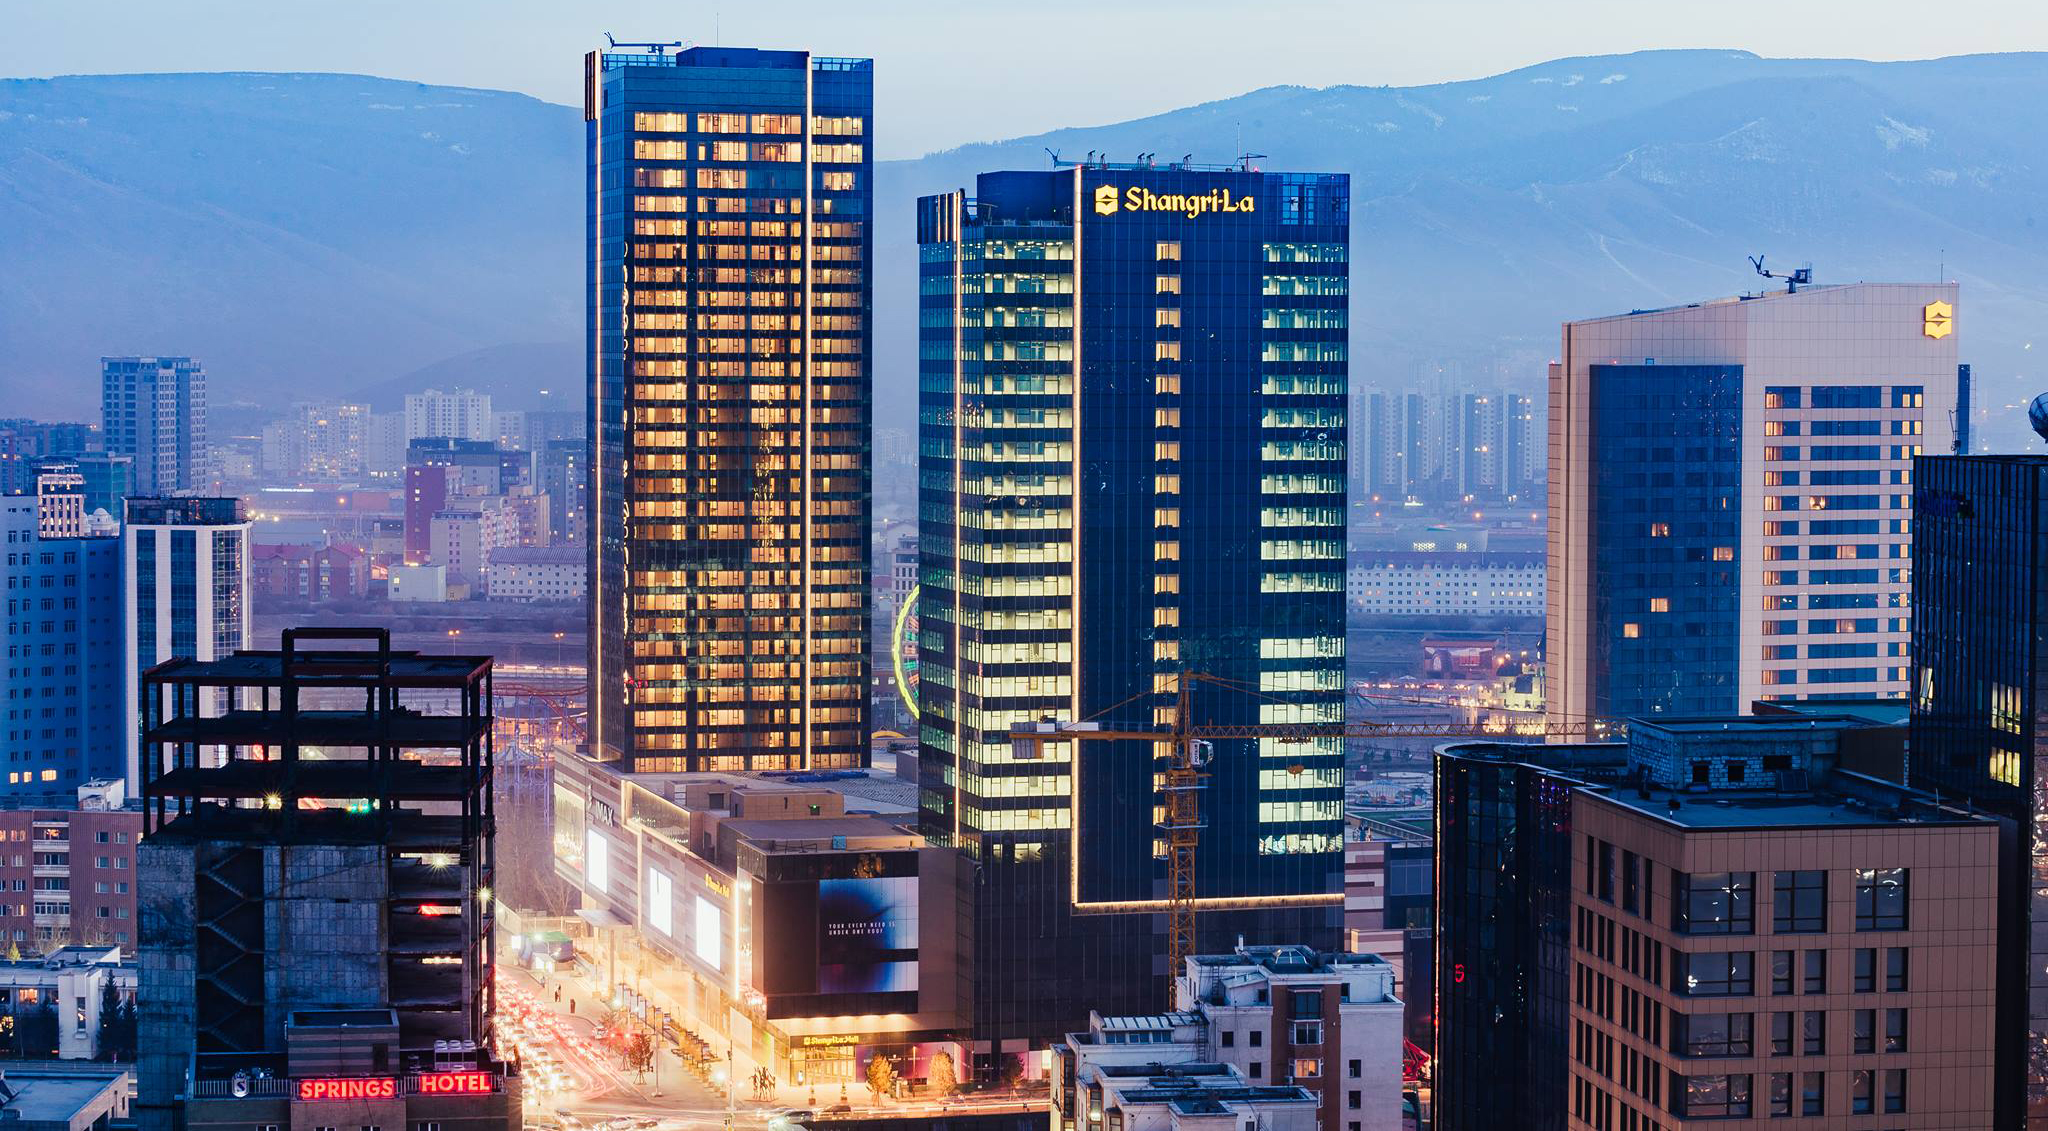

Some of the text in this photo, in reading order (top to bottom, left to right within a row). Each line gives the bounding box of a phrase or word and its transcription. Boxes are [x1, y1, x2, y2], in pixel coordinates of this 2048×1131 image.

[1124, 186, 1255, 219] Shangri-La
[301, 1075, 490, 1098] SPRINGS HOTEL
